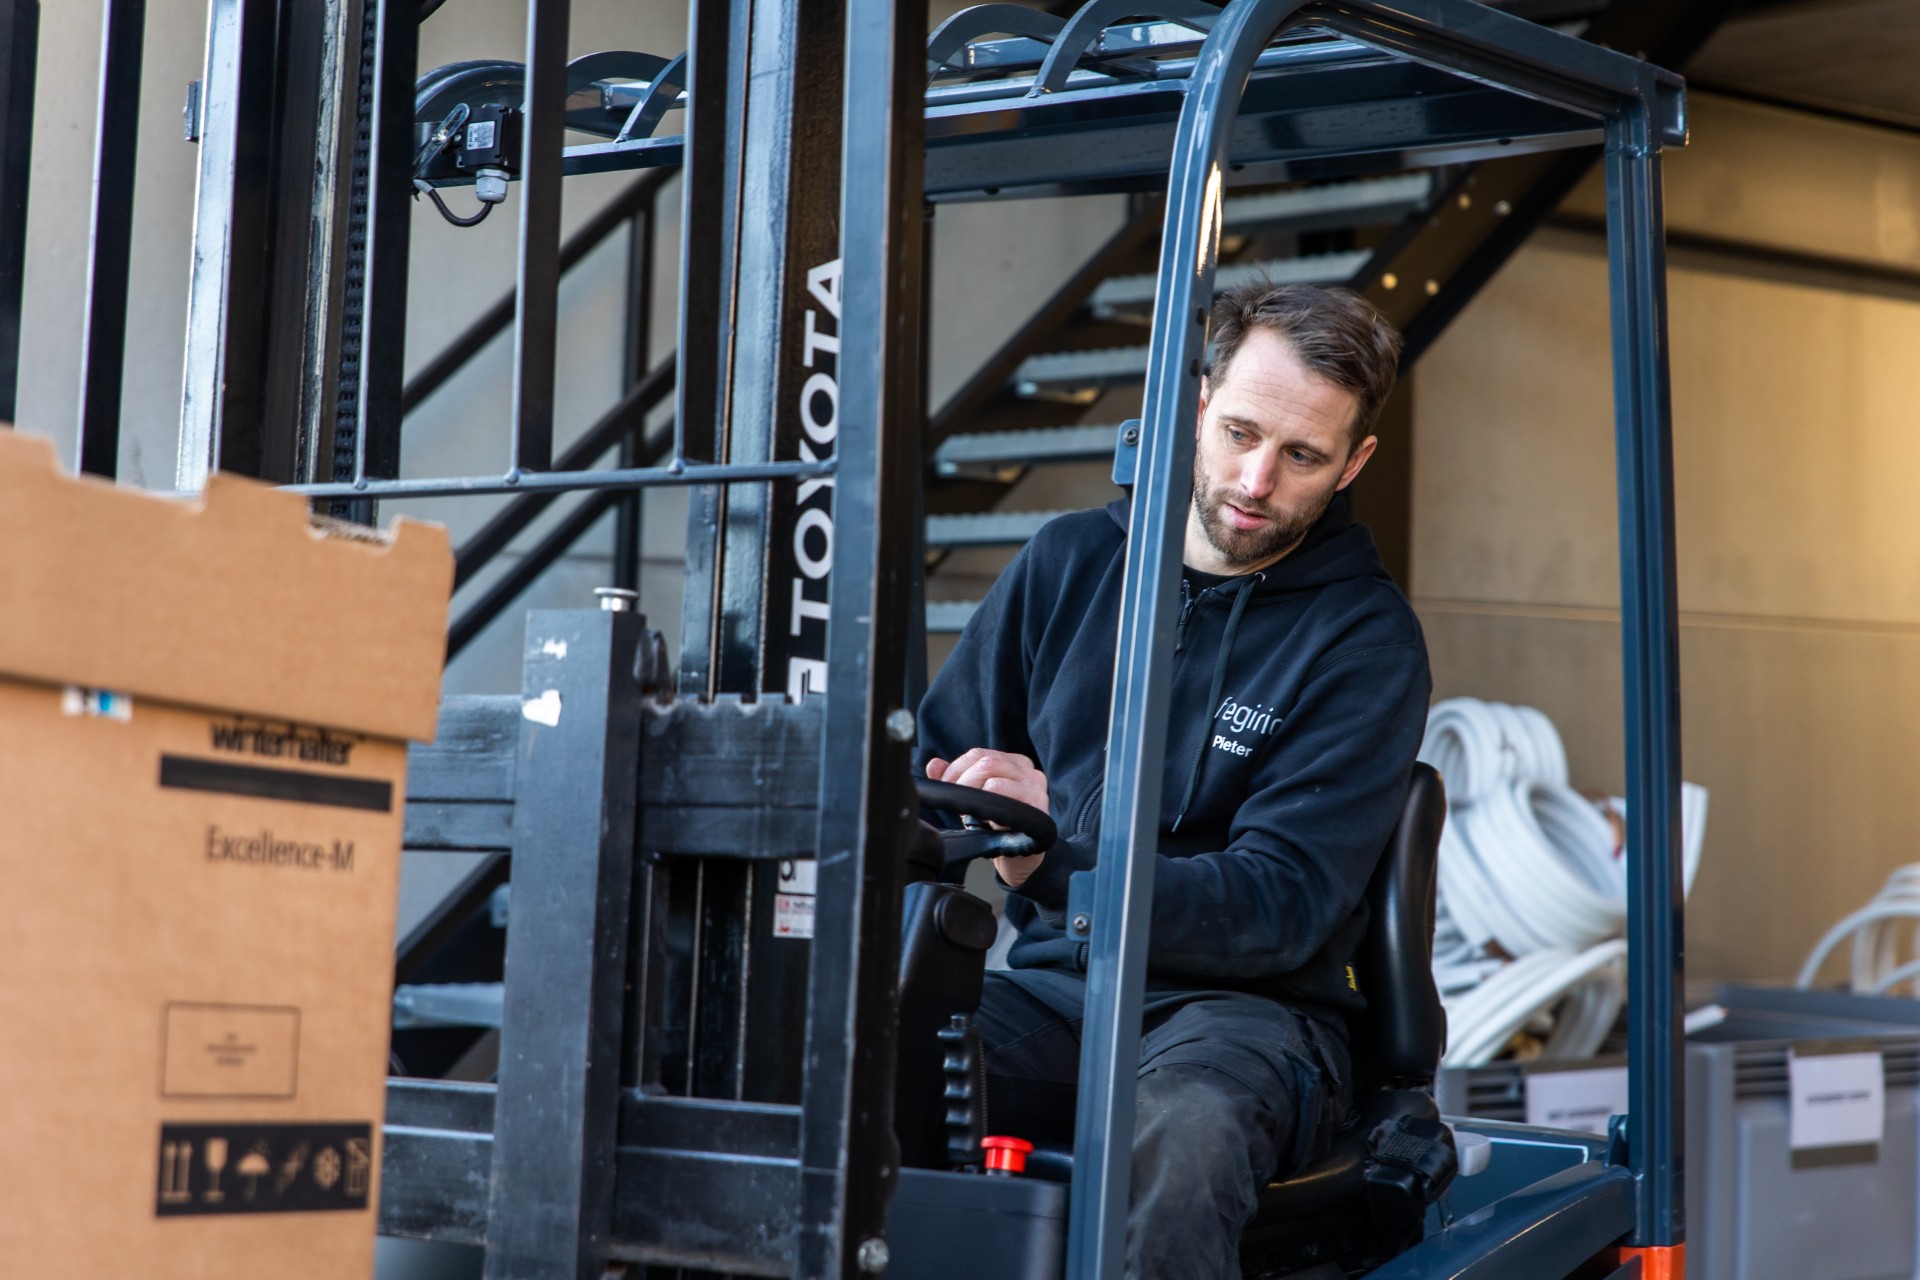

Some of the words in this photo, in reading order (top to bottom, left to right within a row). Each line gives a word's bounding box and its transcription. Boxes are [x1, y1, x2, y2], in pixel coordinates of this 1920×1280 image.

[790, 257, 842, 637] TOYOTA
[1212, 735, 1253, 757] Pieter
[206, 824, 355, 873] Excellence-M
